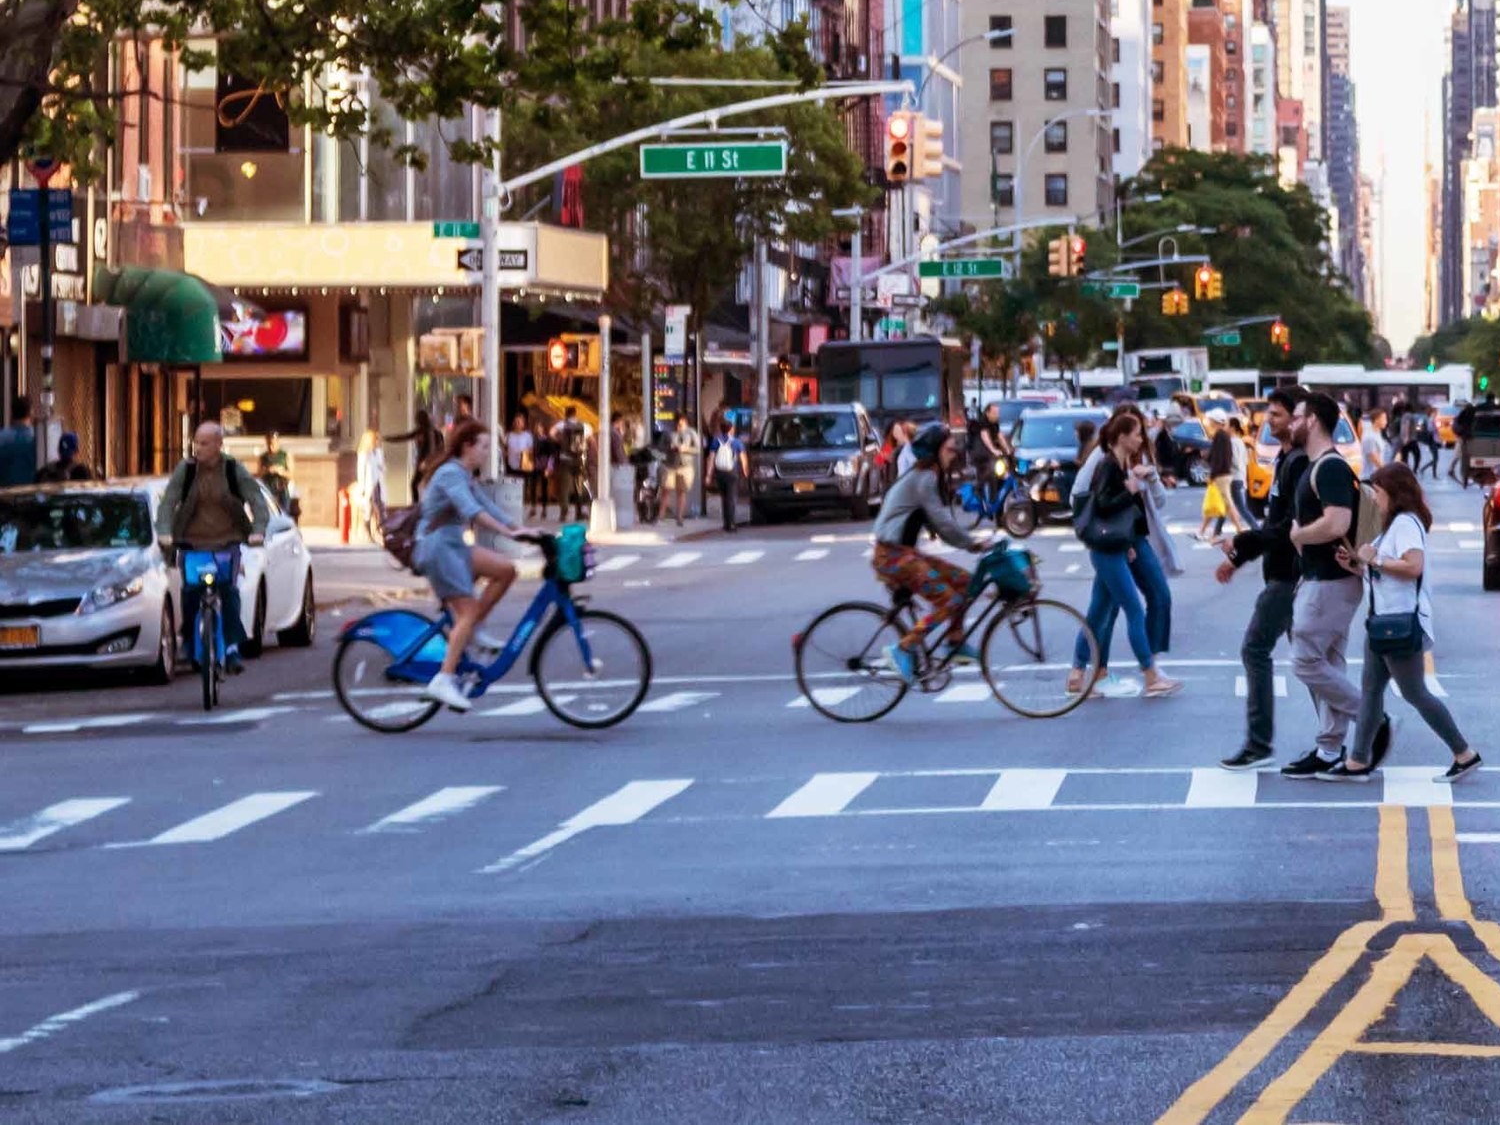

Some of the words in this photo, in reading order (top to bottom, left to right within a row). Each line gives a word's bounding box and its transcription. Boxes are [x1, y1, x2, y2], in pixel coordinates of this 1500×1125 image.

[686, 151, 695, 170] E
[704, 150, 714, 169] 11
[722, 150, 738, 168] St
[943, 266, 949, 275] E
[953, 265, 963, 275] 12
